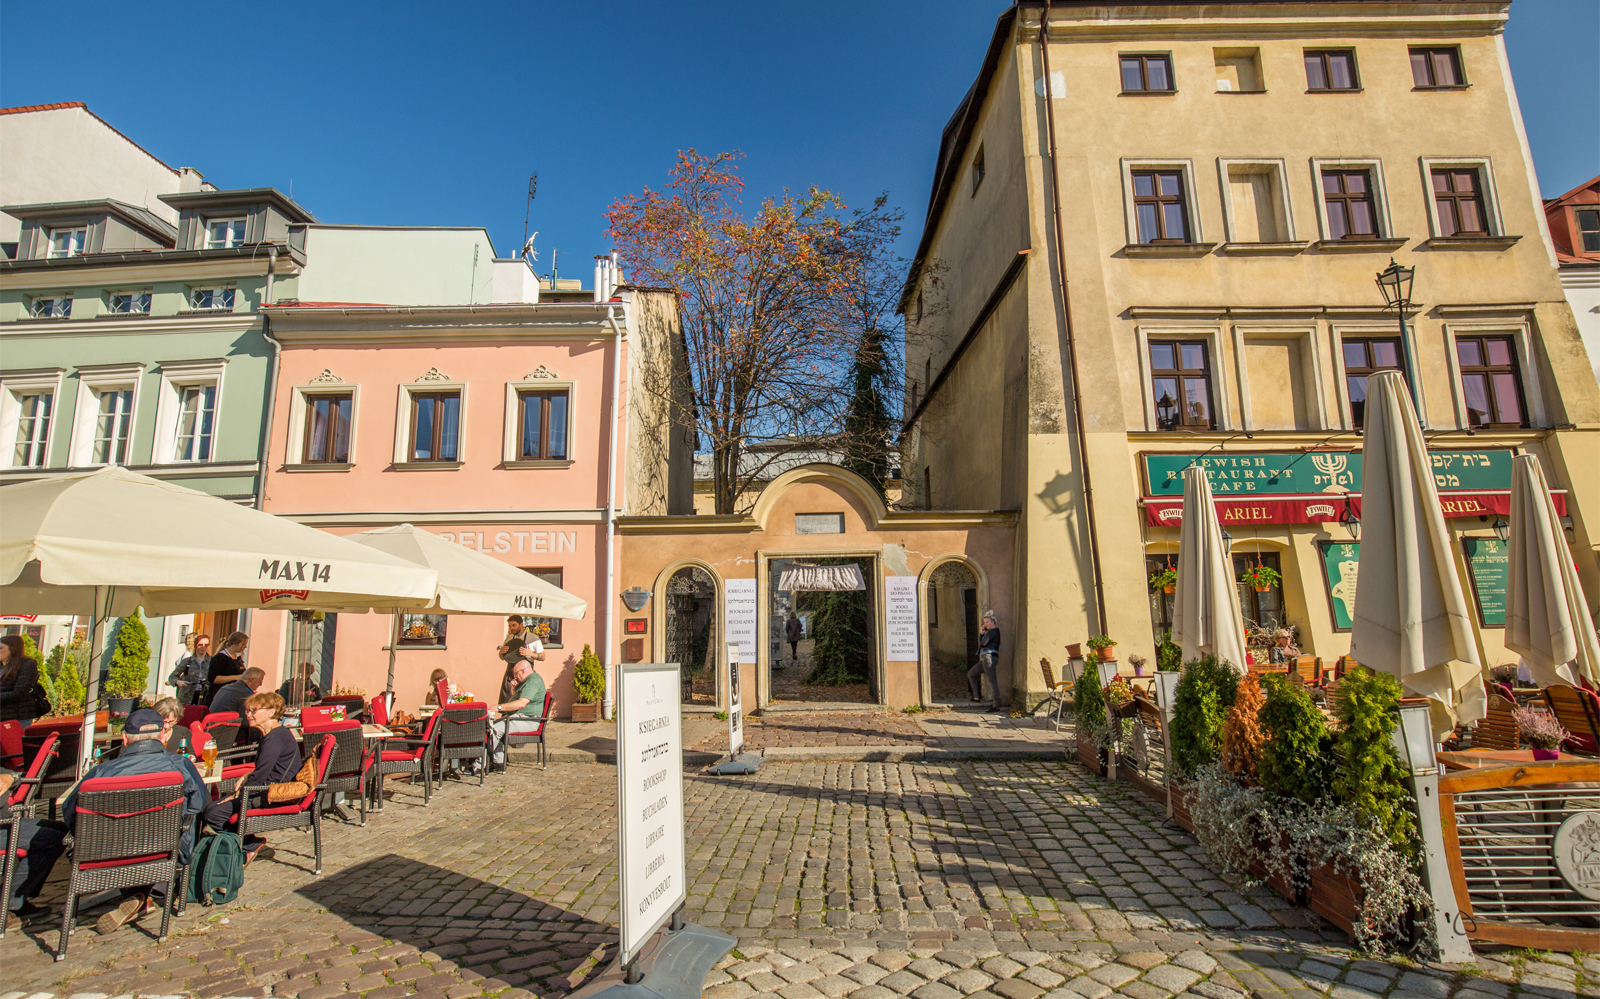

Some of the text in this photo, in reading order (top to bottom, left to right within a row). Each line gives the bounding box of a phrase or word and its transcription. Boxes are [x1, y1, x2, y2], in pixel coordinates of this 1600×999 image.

[1189, 457, 1266, 467] JEWISH
[1428, 453, 1491, 470] בית־קפ
[1166, 469, 1293, 480] RETAURANT
[1210, 481, 1256, 491] CAFE
[1224, 507, 1272, 520] ARIEL
[258, 558, 331, 583] MAX 14
[513, 594, 543, 610] MAX 14
[638, 716, 670, 734] KSIĘGARNIA
[643, 768, 668, 792] BOOKSHOP
[642, 795, 668, 822] BUCHLADEN
[645, 853, 666, 880] LIBRERIA
